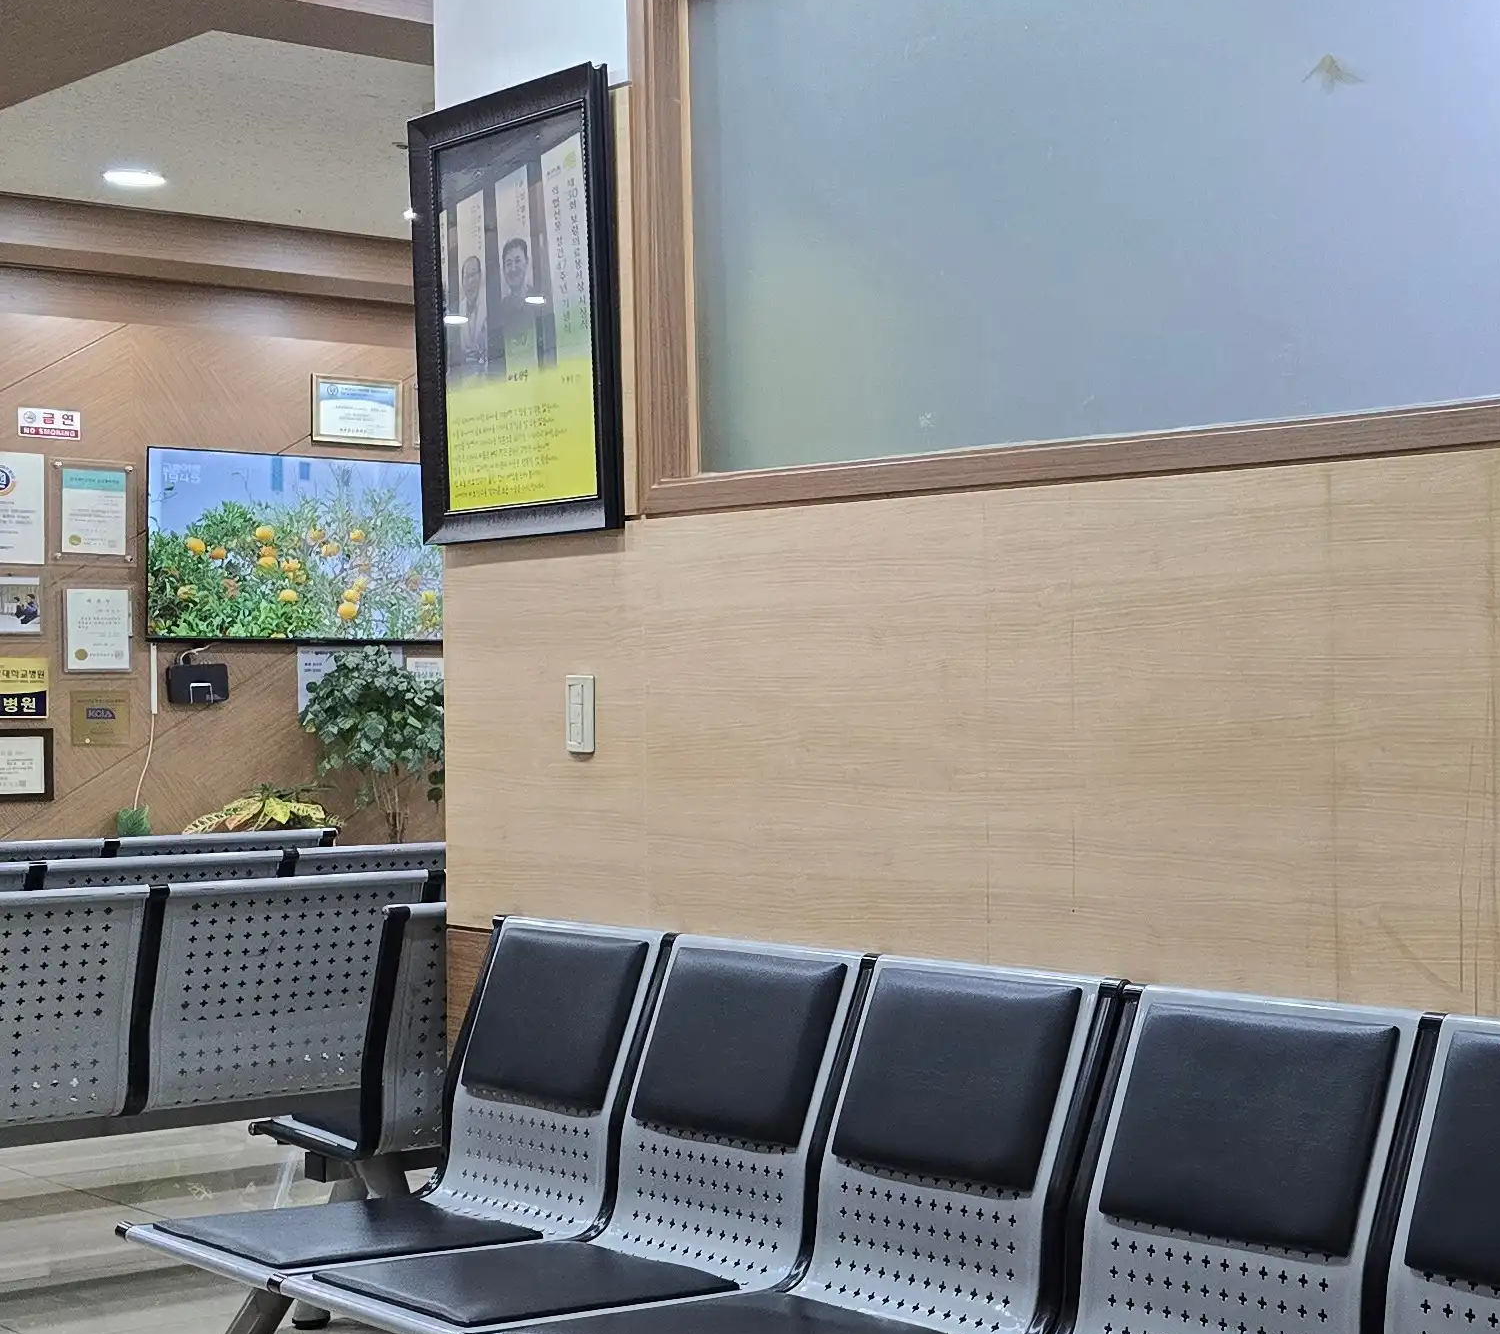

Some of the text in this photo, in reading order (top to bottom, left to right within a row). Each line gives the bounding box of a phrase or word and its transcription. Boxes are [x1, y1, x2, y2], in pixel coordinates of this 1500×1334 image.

[38, 428, 76, 437] SMOKING
[0, 669, 45, 679] 대학교병원
[3, 697, 36, 713] 병원
